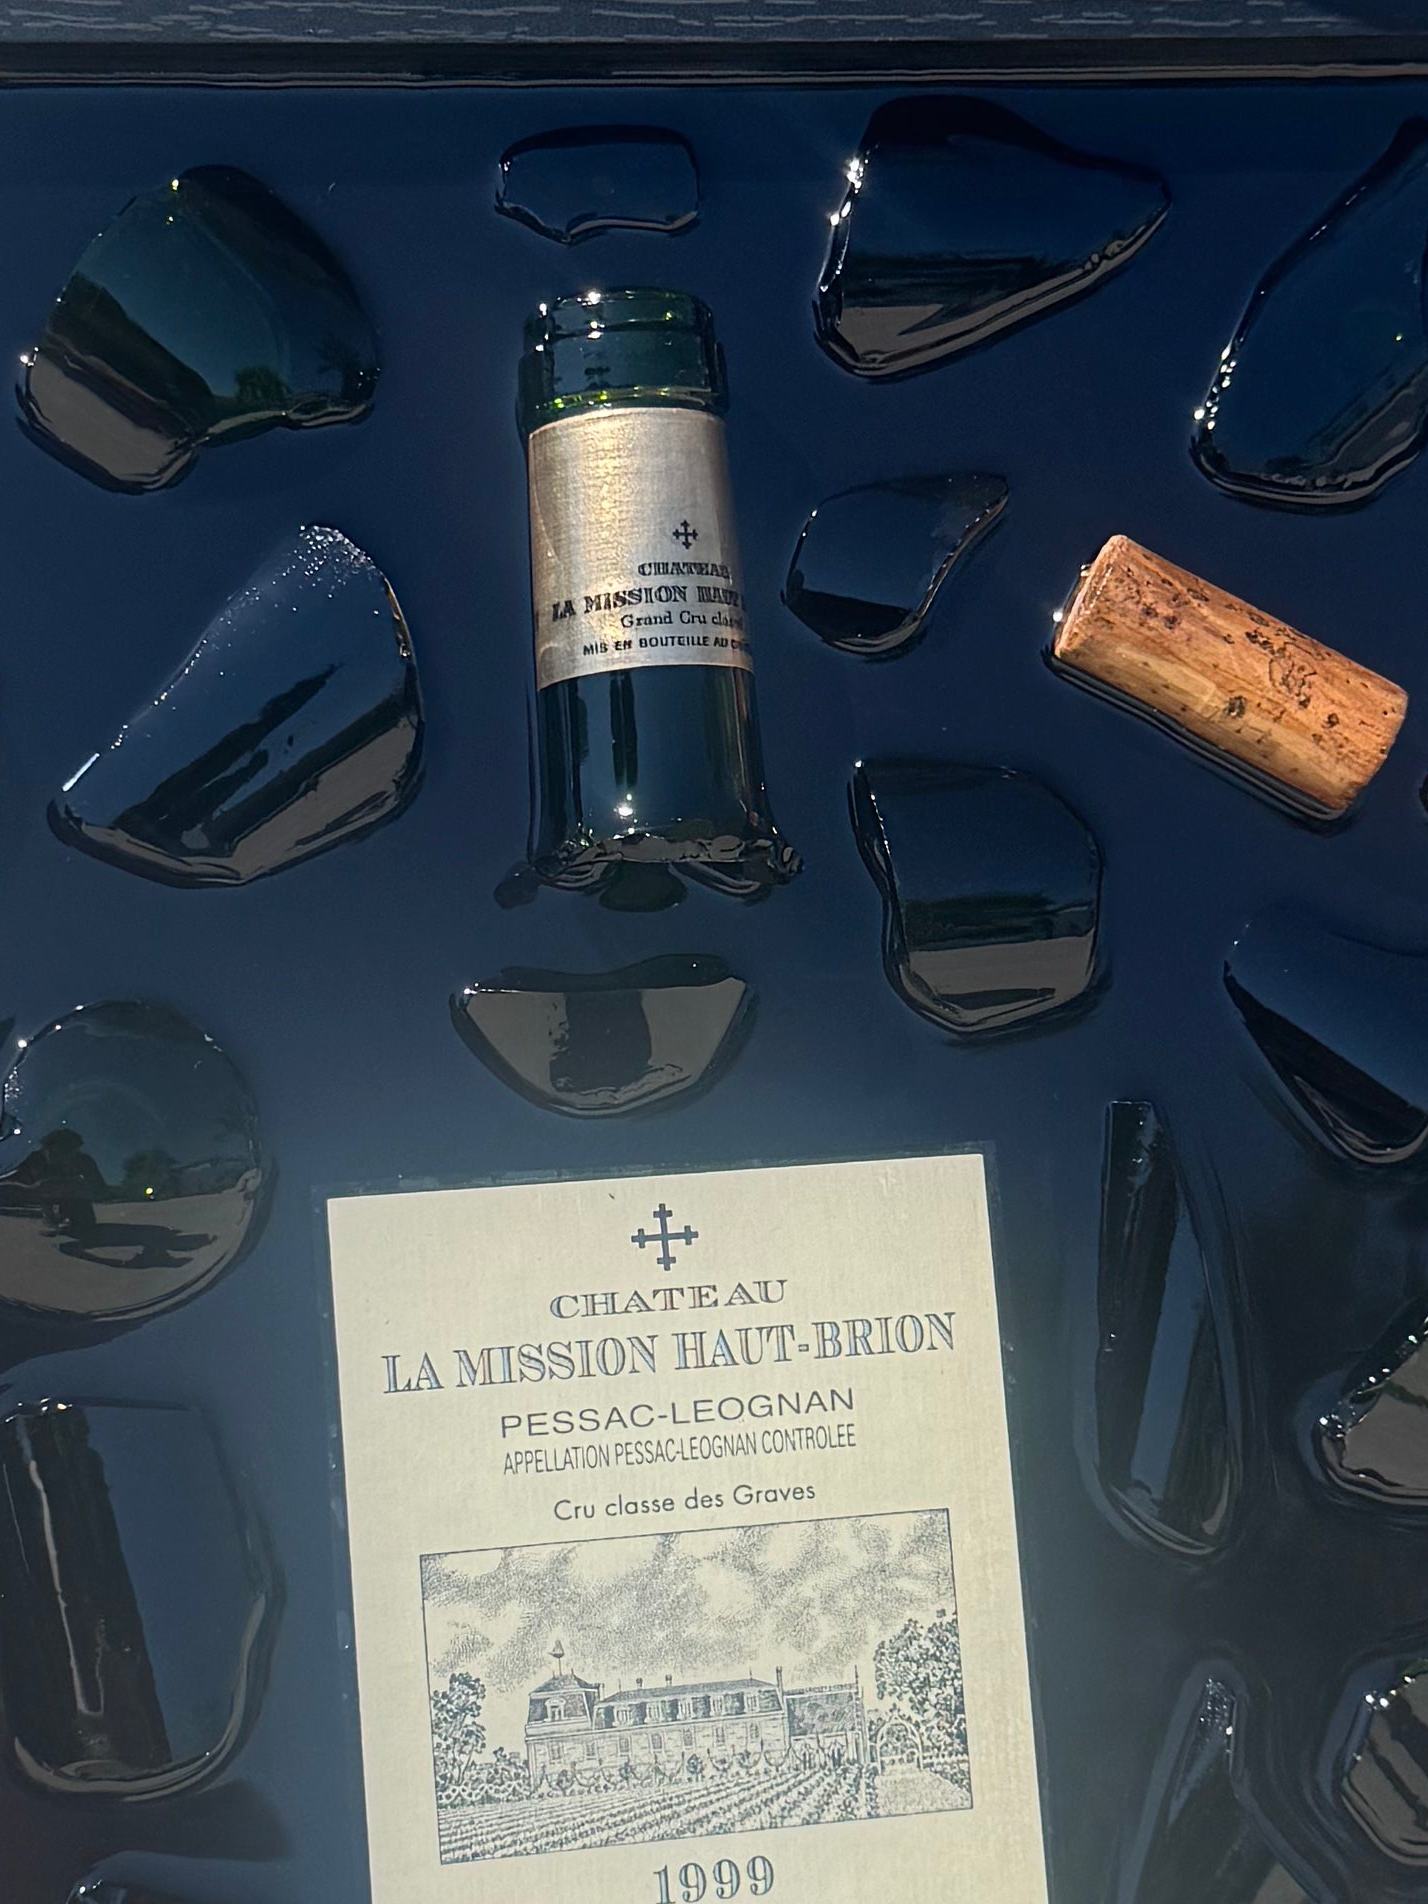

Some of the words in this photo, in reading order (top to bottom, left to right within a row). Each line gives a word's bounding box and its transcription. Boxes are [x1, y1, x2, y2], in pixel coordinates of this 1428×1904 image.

[552, 600, 576, 622] LA
[584, 585, 687, 614] MISSION
[621, 610, 673, 628] Grand
[679, 610, 707, 625] Cru
[583, 641, 608, 656] MIS
[614, 639, 632, 651] EN
[639, 635, 709, 650] BOUTEILLE
[549, 1279, 788, 1319] CHATEAU
[381, 1352, 444, 1394] LA
[453, 1334, 659, 1388] MISSION
[672, 1311, 956, 1370] HAUT-BRION
[500, 1387, 855, 1438] PESSAC-LEOGNAN
[503, 1444, 610, 1475] APPELLATION
[614, 1431, 757, 1465] PESSAC-LEOGNAN
[762, 1423, 857, 1454] CONTROLEE
[553, 1499, 595, 1520] Cru
[605, 1493, 675, 1516] classe
[684, 1486, 724, 1510] des
[732, 1483, 817, 1506] Graves
